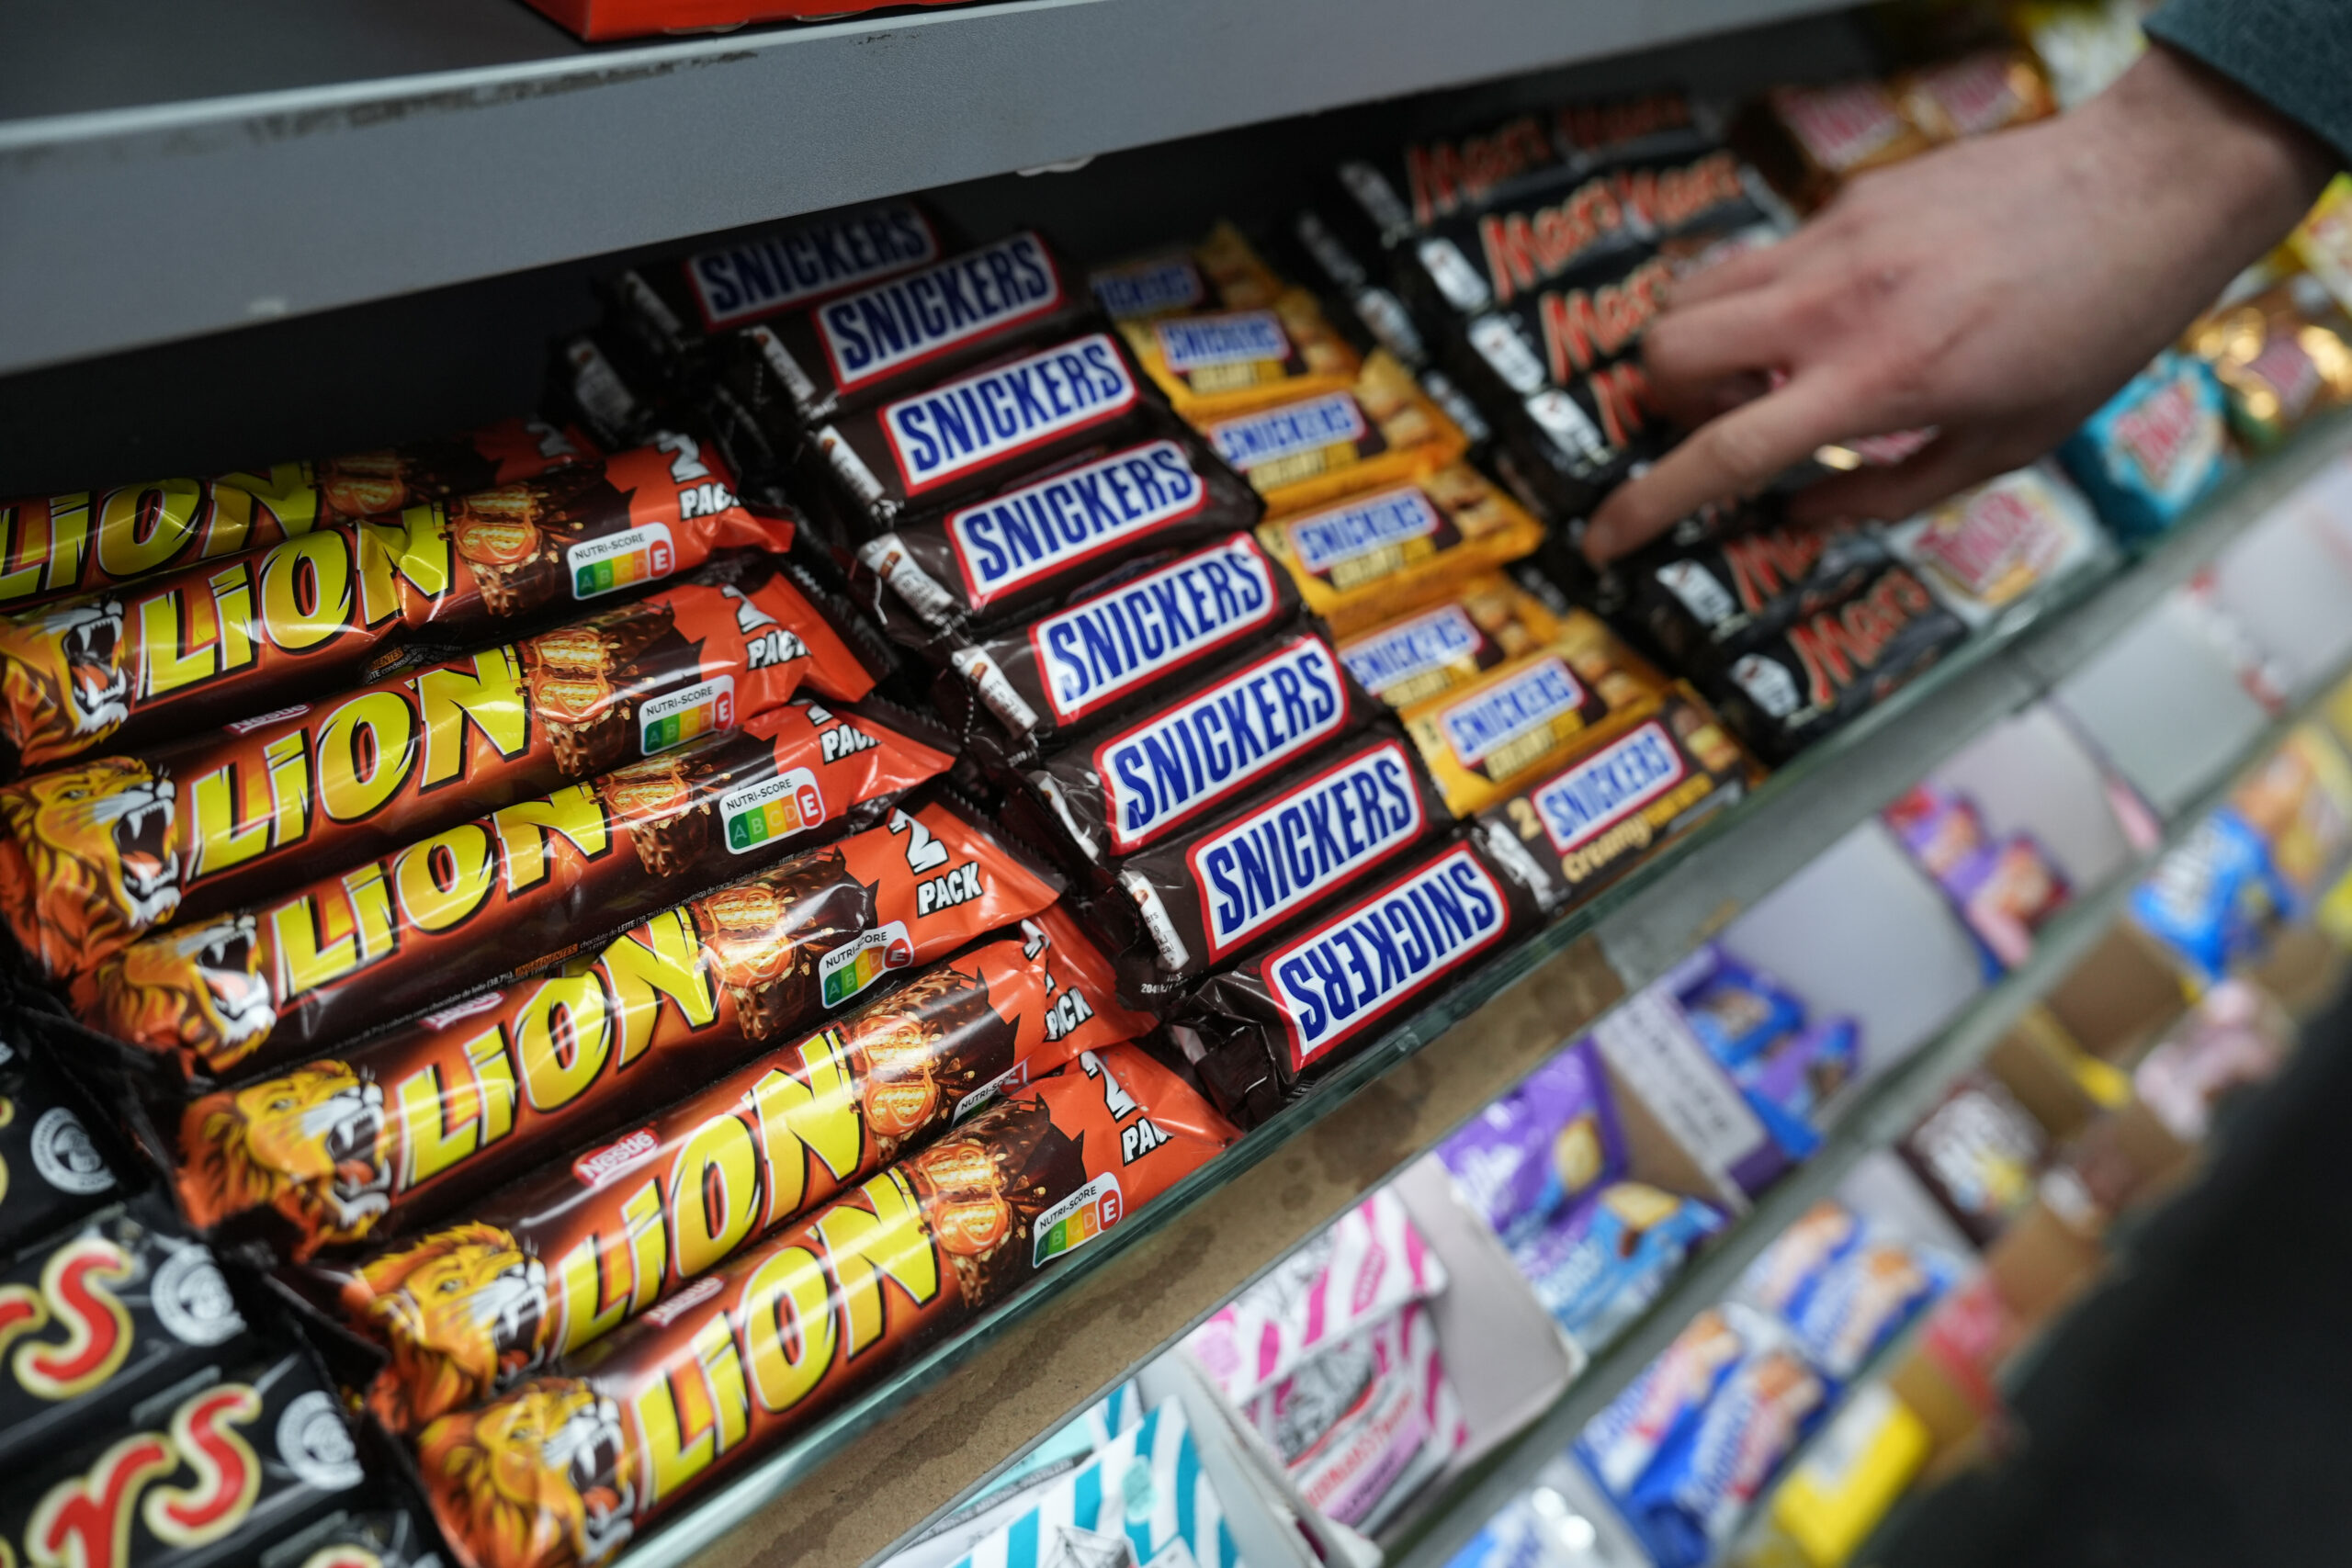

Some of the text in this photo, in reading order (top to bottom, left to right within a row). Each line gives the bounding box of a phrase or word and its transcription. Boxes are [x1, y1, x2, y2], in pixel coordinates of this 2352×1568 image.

[695, 208, 932, 323] SNICKERS
[1480, 176, 1623, 304] Mars
[820, 238, 1053, 373] SNICKERS
[895, 338, 1128, 474] SNICKERS
[656, 430, 711, 483] 2
[574, 533, 645, 560] NUTRI-SCORE
[963, 447, 1194, 583] SNICKERS
[653, 548, 668, 571] E
[1046, 549, 1265, 703] SNICKERS
[1788, 566, 1930, 708] Mars
[646, 685, 713, 716] NUTRI-SCORE
[718, 703, 729, 721] E
[1112, 651, 1336, 831] SNICKERS
[726, 778, 792, 810] NUTRI-SCORE
[803, 794, 820, 818] E
[1507, 797, 1542, 840] 2
[1544, 732, 1672, 838] SNICKERS
[888, 807, 949, 876] 2
[1205, 757, 1413, 936] SNICKERS
[917, 861, 984, 919] PACK
[429, 993, 461, 1011] chocolate
[580, 931, 608, 949] chocolate
[609, 928, 617, 937] de
[617, 919, 636, 933] LEITE
[889, 947, 907, 963] E
[1277, 860, 1497, 1043] SNICKERS
[1079, 1050, 1138, 1123] 2
[1120, 1116, 1174, 1168] PA
[1039, 1186, 1097, 1230] NUTRI-SCORE
[1102, 1198, 1117, 1223] E
